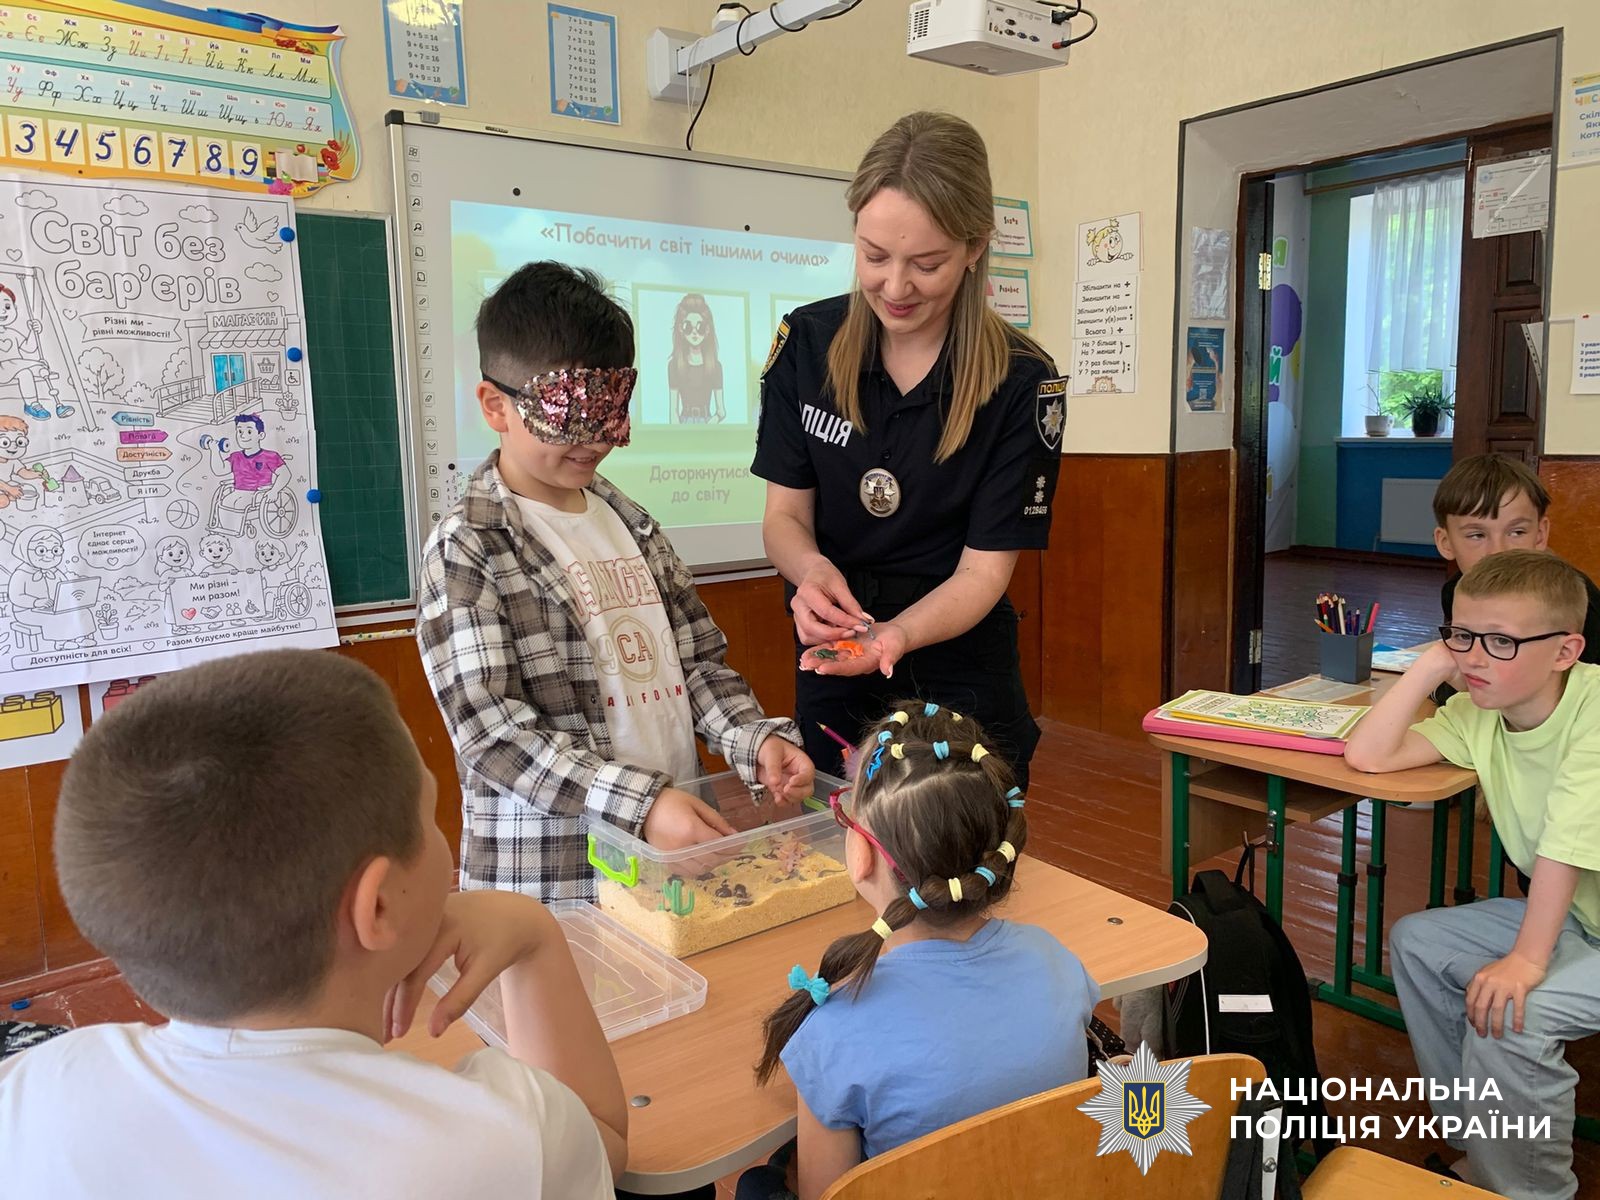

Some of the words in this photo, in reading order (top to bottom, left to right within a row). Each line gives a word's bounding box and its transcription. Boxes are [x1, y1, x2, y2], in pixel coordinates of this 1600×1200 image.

[14, 123, 37, 154] 3
[55, 128, 79, 157] 4
[95, 131, 117, 161] 5
[133, 135, 153, 165] 6
[168, 138, 187, 168] 7
[206, 143, 222, 173] 8
[240, 148, 259, 176] 9
[30, 209, 143, 258] Світ
[154, 222, 226, 263] без
[540, 222, 651, 251] «Побачити
[659, 236, 693, 255] світ
[700, 239, 763, 262] іншими
[770, 249, 829, 267] очима»
[104, 316, 127, 326] Різні
[212, 311, 279, 329] МАГАЗИН
[92, 328, 114, 337] рівні
[116, 329, 171, 338] можливості!
[121, 415, 151, 423] Рівність
[132, 469, 161, 478] Дружба
[649, 464, 750, 484] Доторкнутися
[671, 490, 690, 504] до
[696, 485, 731, 504] світу
[190, 583, 205, 591] Ми
[207, 579, 229, 590] різні
[208, 588, 240, 602] разом!
[166, 637, 193, 646] Разом
[194, 632, 231, 643] будуємо
[232, 629, 259, 638] краще
[30, 652, 89, 665] Доступність
[91, 648, 108, 657] для
[110, 645, 132, 654] всіх!
[616, 631, 653, 664] CA
